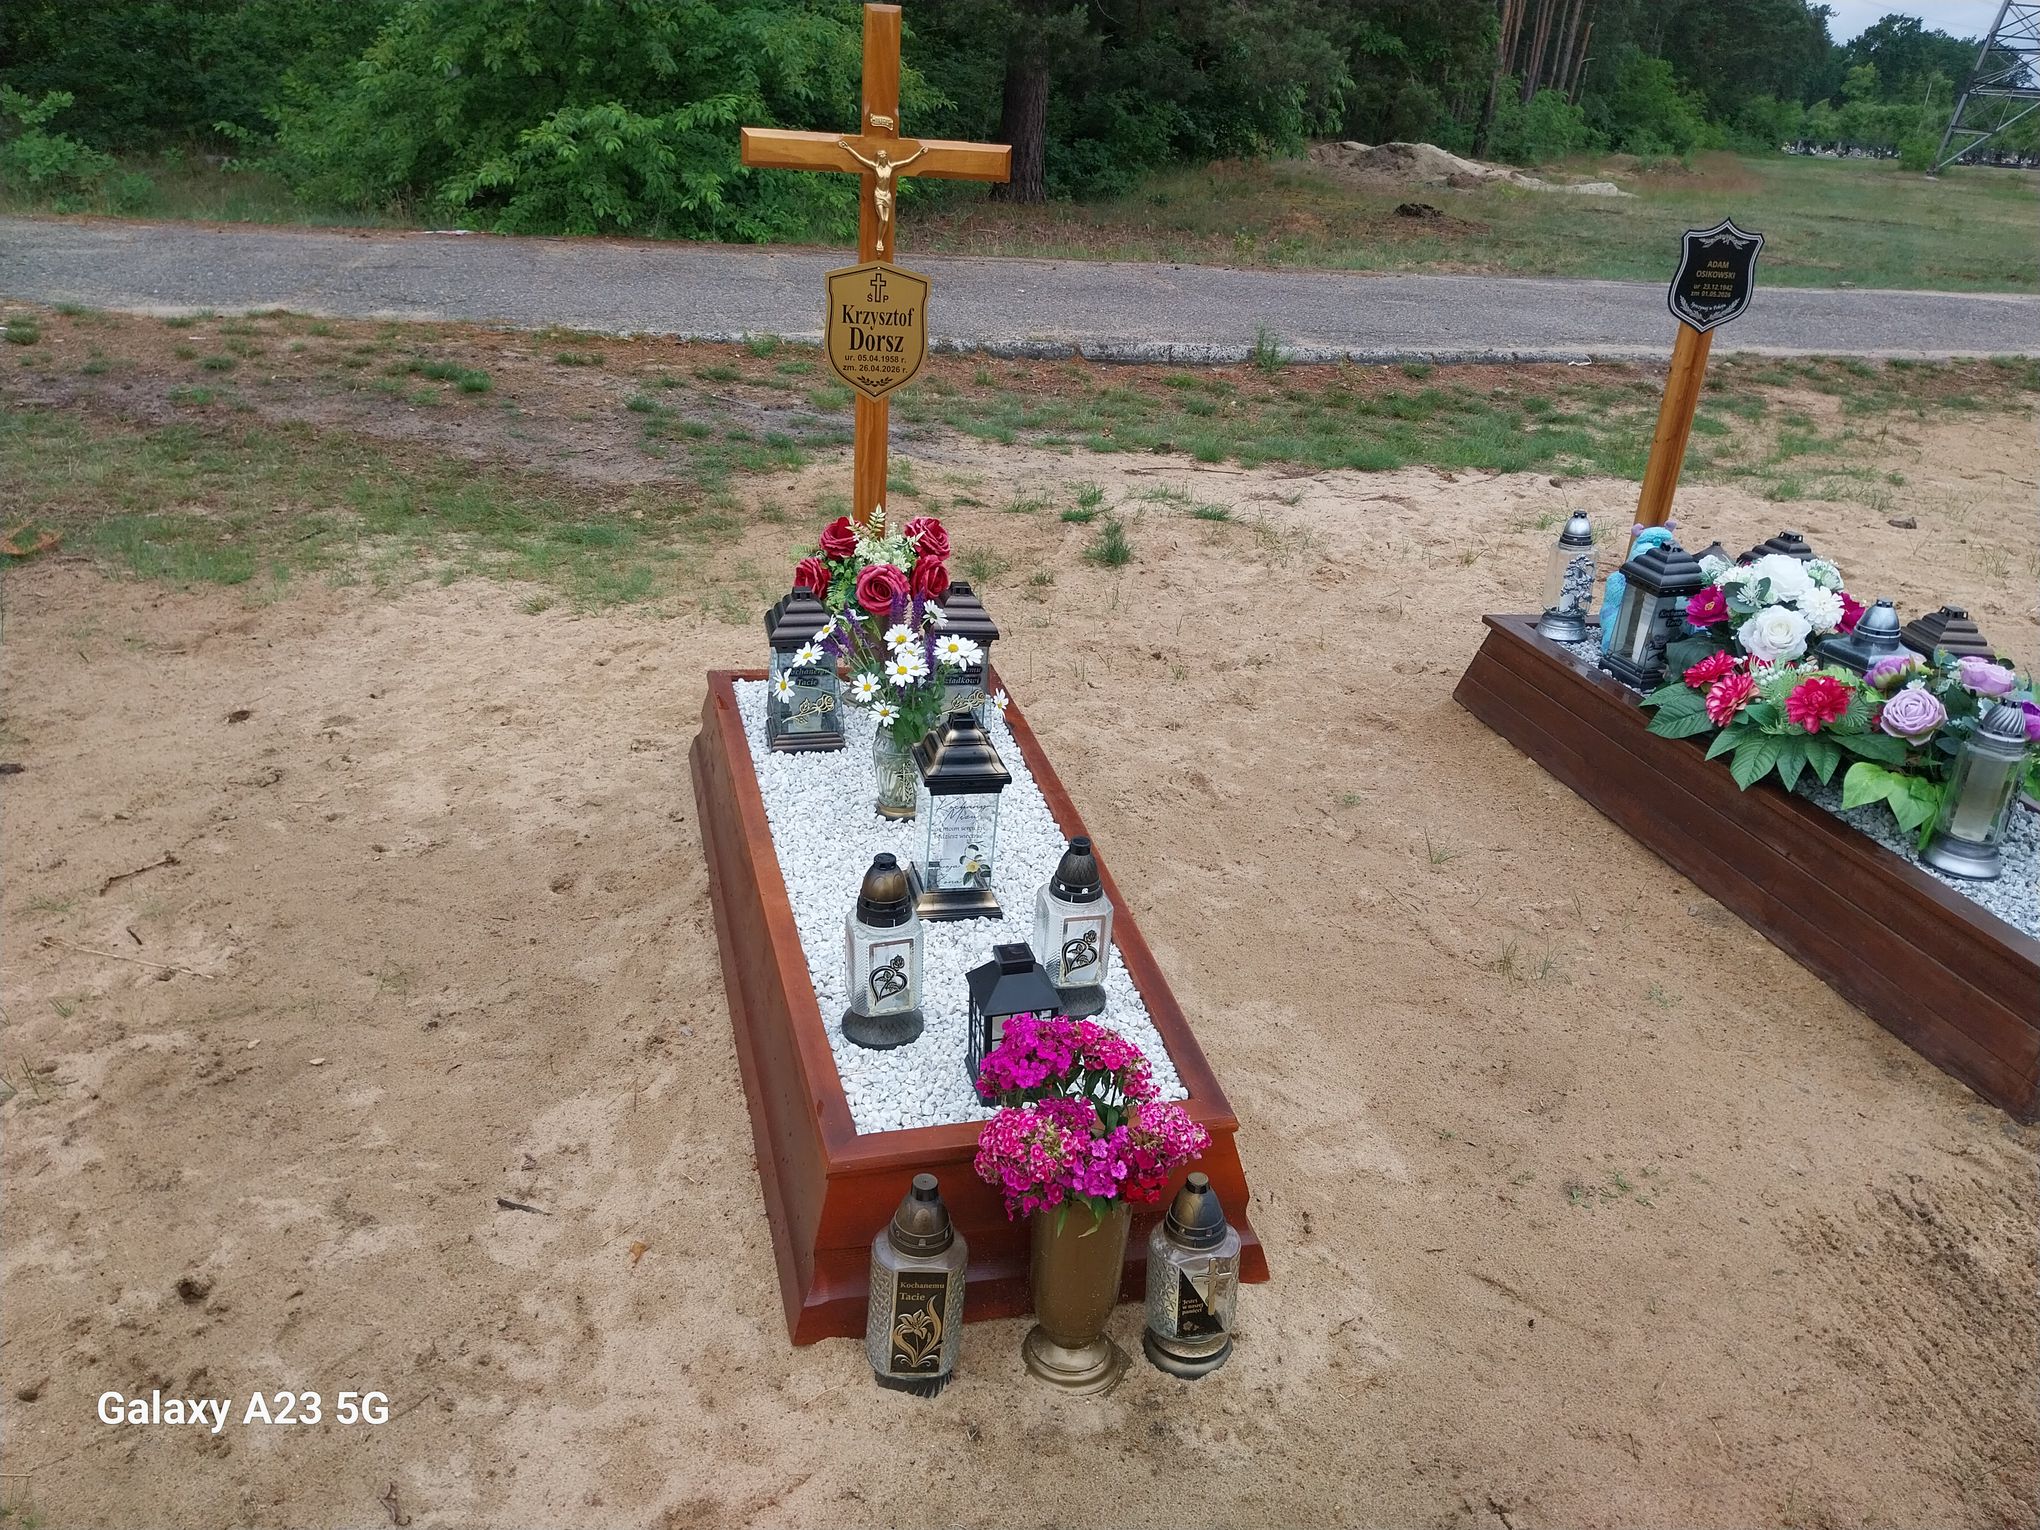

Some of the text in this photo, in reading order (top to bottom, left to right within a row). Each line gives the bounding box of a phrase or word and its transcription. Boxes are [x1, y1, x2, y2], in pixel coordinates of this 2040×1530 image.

[1707, 260, 1730, 269] ADAM
[1696, 270, 1736, 279] OSIKOWSKI
[842, 304, 914, 330] Krzysztof
[849, 326, 904, 353] Dorsz
[857, 354, 899, 364] 05.04.1958
[859, 364, 901, 374] 26.04.2026
[944, 676, 980, 684] ziadkowi
[900, 1281, 945, 1289] Kochanemu
[900, 1292, 926, 1301] Tacie
